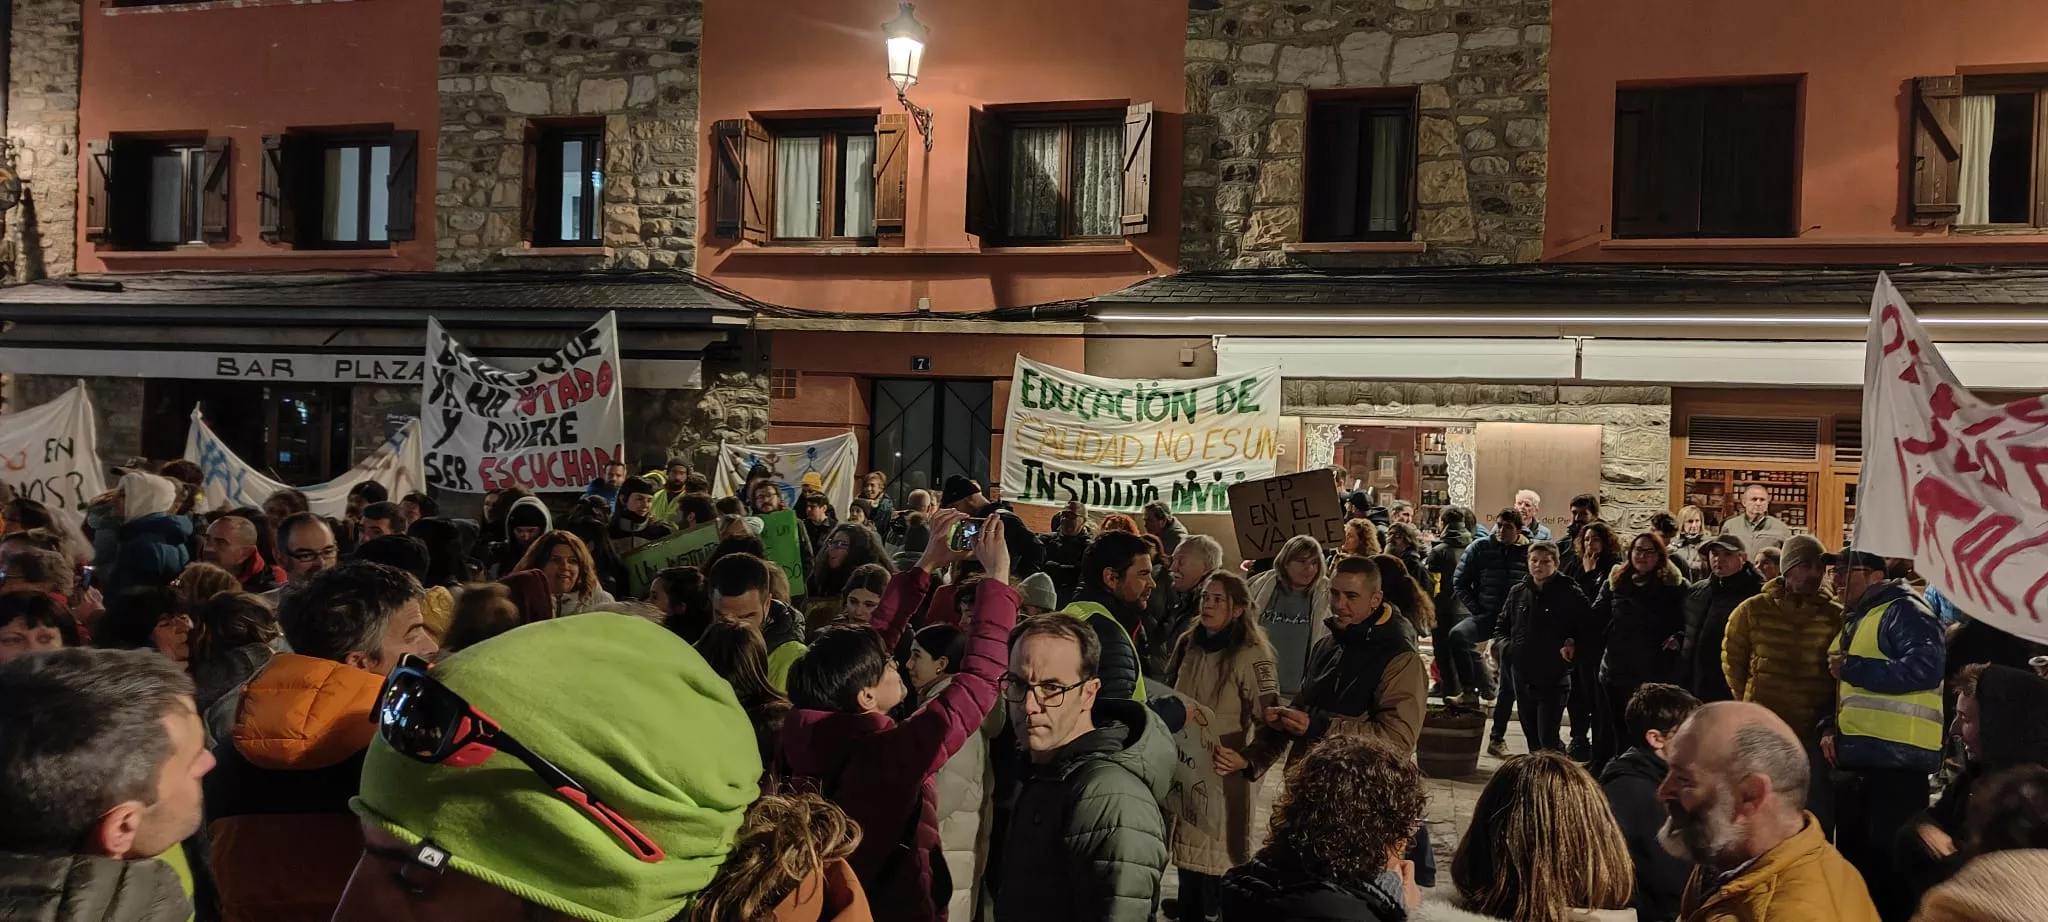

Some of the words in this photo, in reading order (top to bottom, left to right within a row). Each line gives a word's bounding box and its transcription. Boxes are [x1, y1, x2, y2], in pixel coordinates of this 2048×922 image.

[216, 357, 294, 377] BAR
[335, 360, 424, 380] PLAZA
[917, 358, 925, 370] 7
[428, 366, 462, 410] YA
[465, 382, 511, 418] HA
[1216, 377, 1260, 415] DE
[432, 409, 463, 449] Y
[1016, 417, 1144, 469] CALIDAD
[1153, 428, 1194, 463] NO
[44, 437, 74, 463] EN
[424, 452, 473, 490] SER
[479, 444, 622, 491] ESCUCHAD
[1017, 459, 1159, 505] INSTITUTO
[1249, 503, 1279, 526] EN
[1290, 497, 1321, 520] EL
